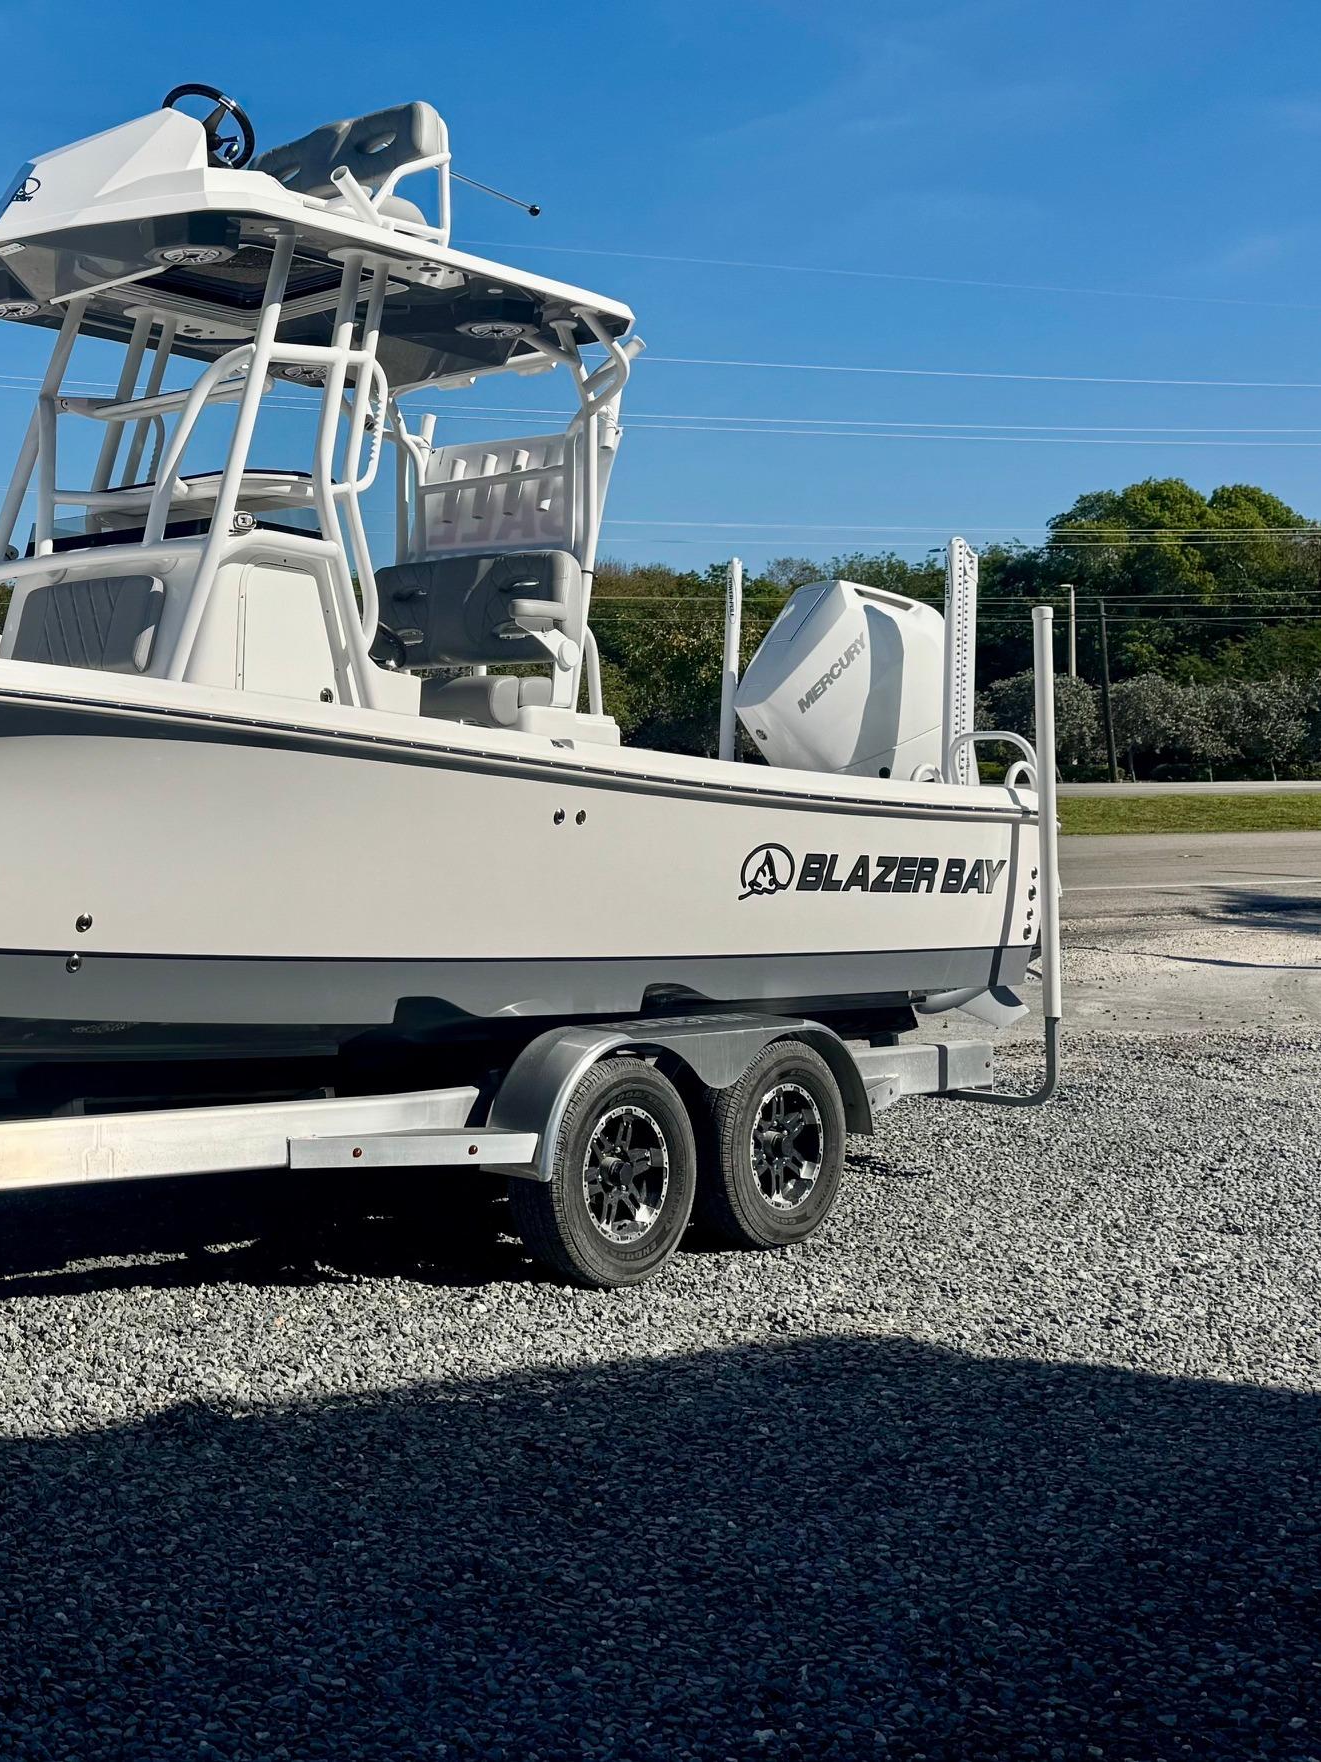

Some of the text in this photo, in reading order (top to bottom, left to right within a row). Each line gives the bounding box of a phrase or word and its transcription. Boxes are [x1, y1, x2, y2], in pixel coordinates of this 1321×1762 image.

[798, 632, 865, 714] MERCURY
[796, 853, 1007, 894] BLAZER BAY
